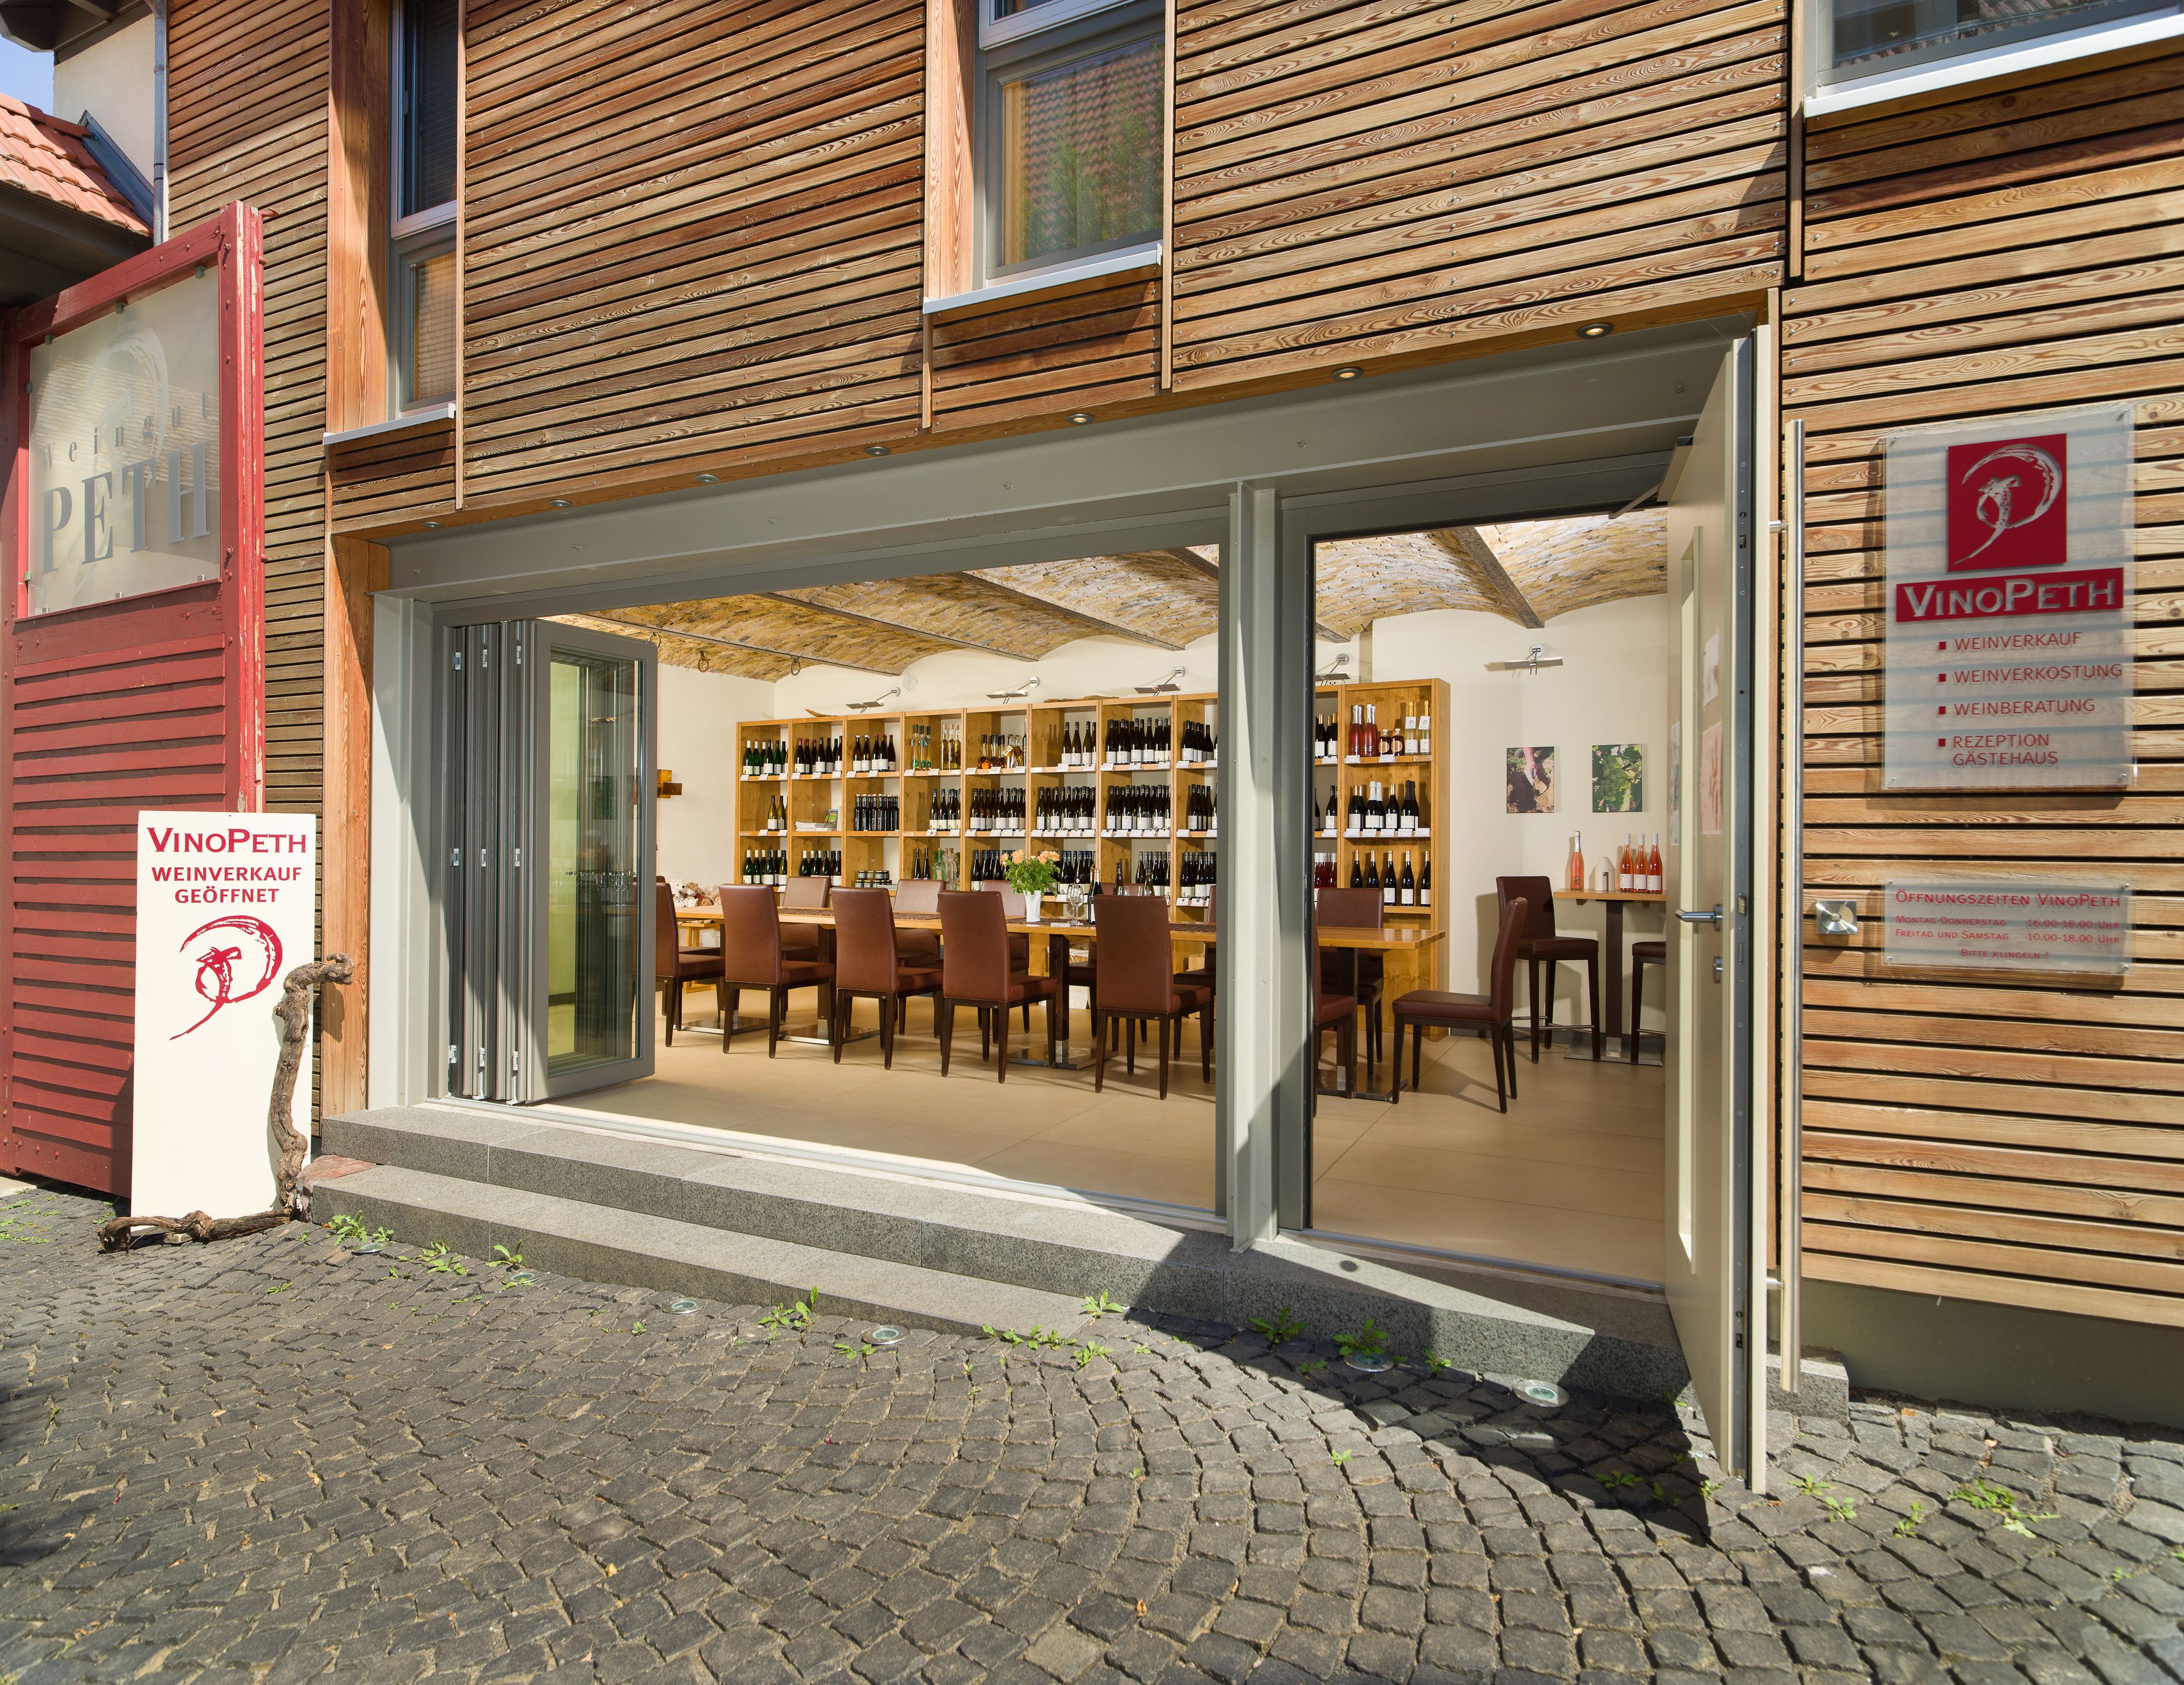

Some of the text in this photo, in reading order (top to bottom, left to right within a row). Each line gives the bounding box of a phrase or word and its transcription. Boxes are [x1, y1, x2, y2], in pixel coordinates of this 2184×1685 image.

[41, 441, 211, 574] PETH
[1954, 632, 2082, 651] WEINVERKAUF
[1954, 664, 2122, 683] WEINVERKOSTUNG
[1954, 698, 2095, 716] WEINBERATUNG
[1953, 733, 2050, 748] REZEPTION
[1953, 751, 2058, 766] GÄSTEHAUS
[151, 867, 302, 882] WEINVERKAUF
[174, 885, 279, 904] GEÖFFNET
[2027, 933, 2093, 943] 10.00-18.00
